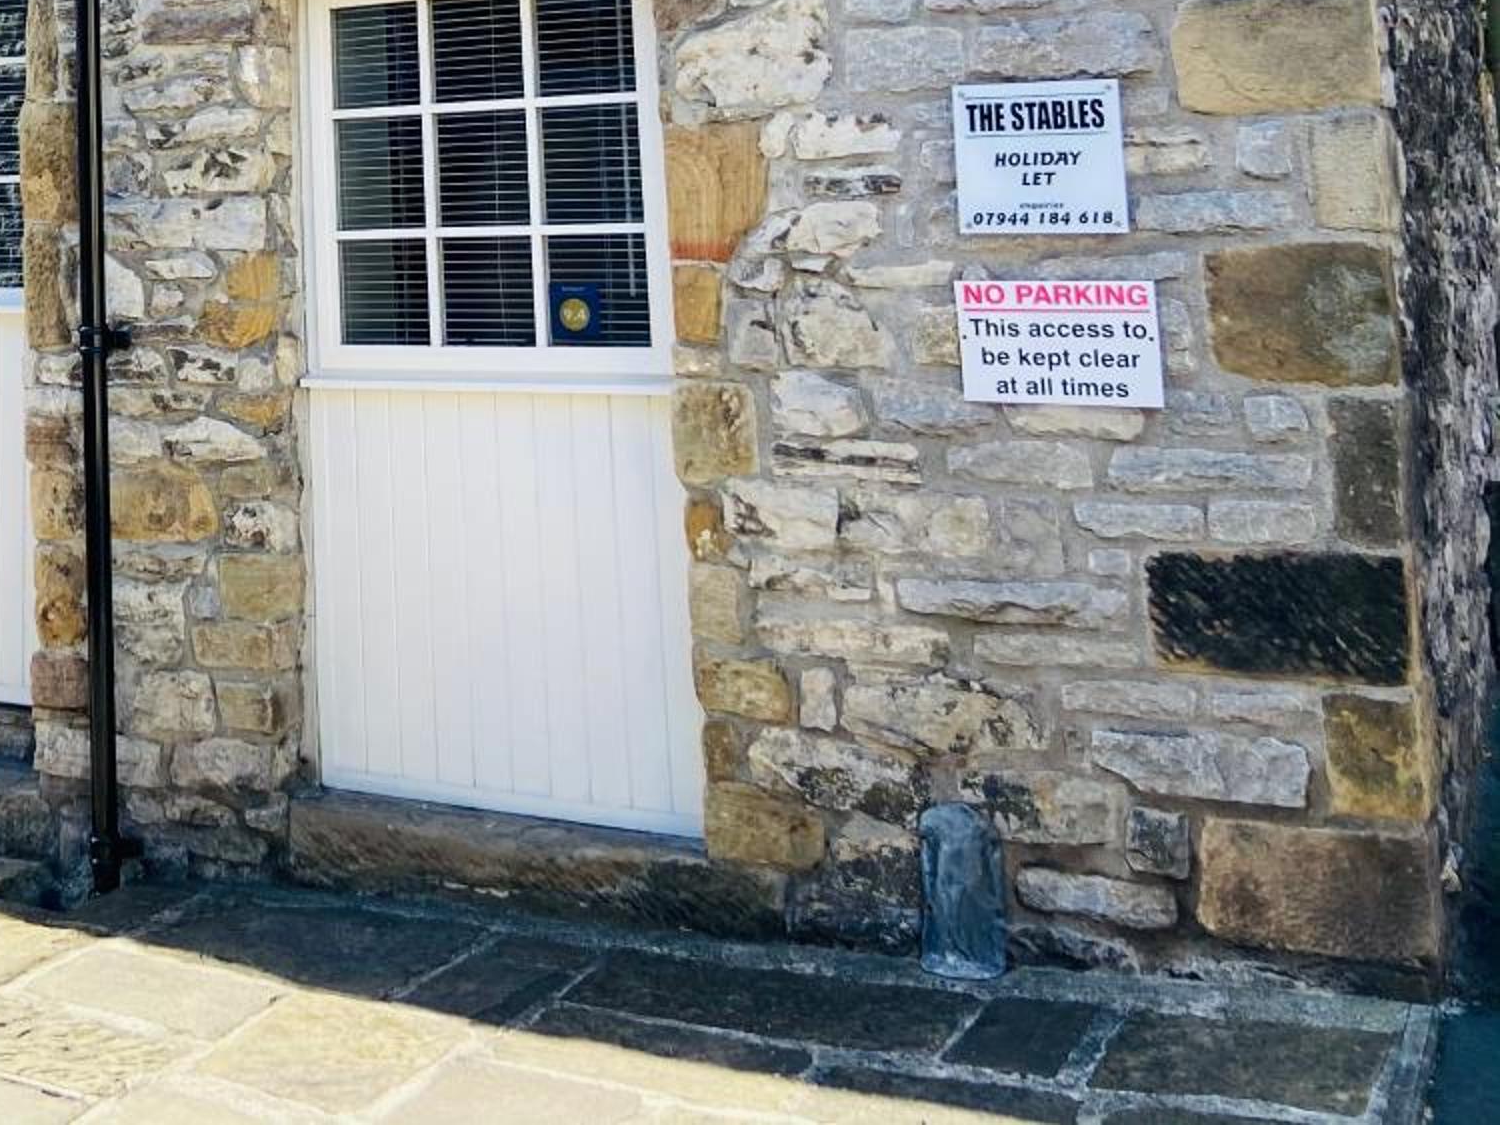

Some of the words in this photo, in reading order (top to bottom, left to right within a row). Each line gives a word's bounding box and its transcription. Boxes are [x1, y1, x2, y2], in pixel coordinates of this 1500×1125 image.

[965, 104, 1005, 132] THE
[1010, 99, 1105, 131] STABLES
[995, 151, 1082, 167] HOLIDAY
[1021, 172, 1056, 186] LET
[973, 212, 1029, 226] 07944
[1039, 212, 1071, 225] 184
[1079, 211, 1113, 224] 618
[963, 285, 1005, 304] NO
[1015, 285, 1148, 306] PARKING
[969, 318, 1020, 338] This
[1029, 323, 1115, 338] access
[981, 347, 1010, 366] be
[1018, 348, 1071, 371] kept
[1079, 349, 1141, 368] clear
[996, 378, 1018, 394] at
[1026, 378, 1053, 396] all
[1061, 378, 1130, 398] times
